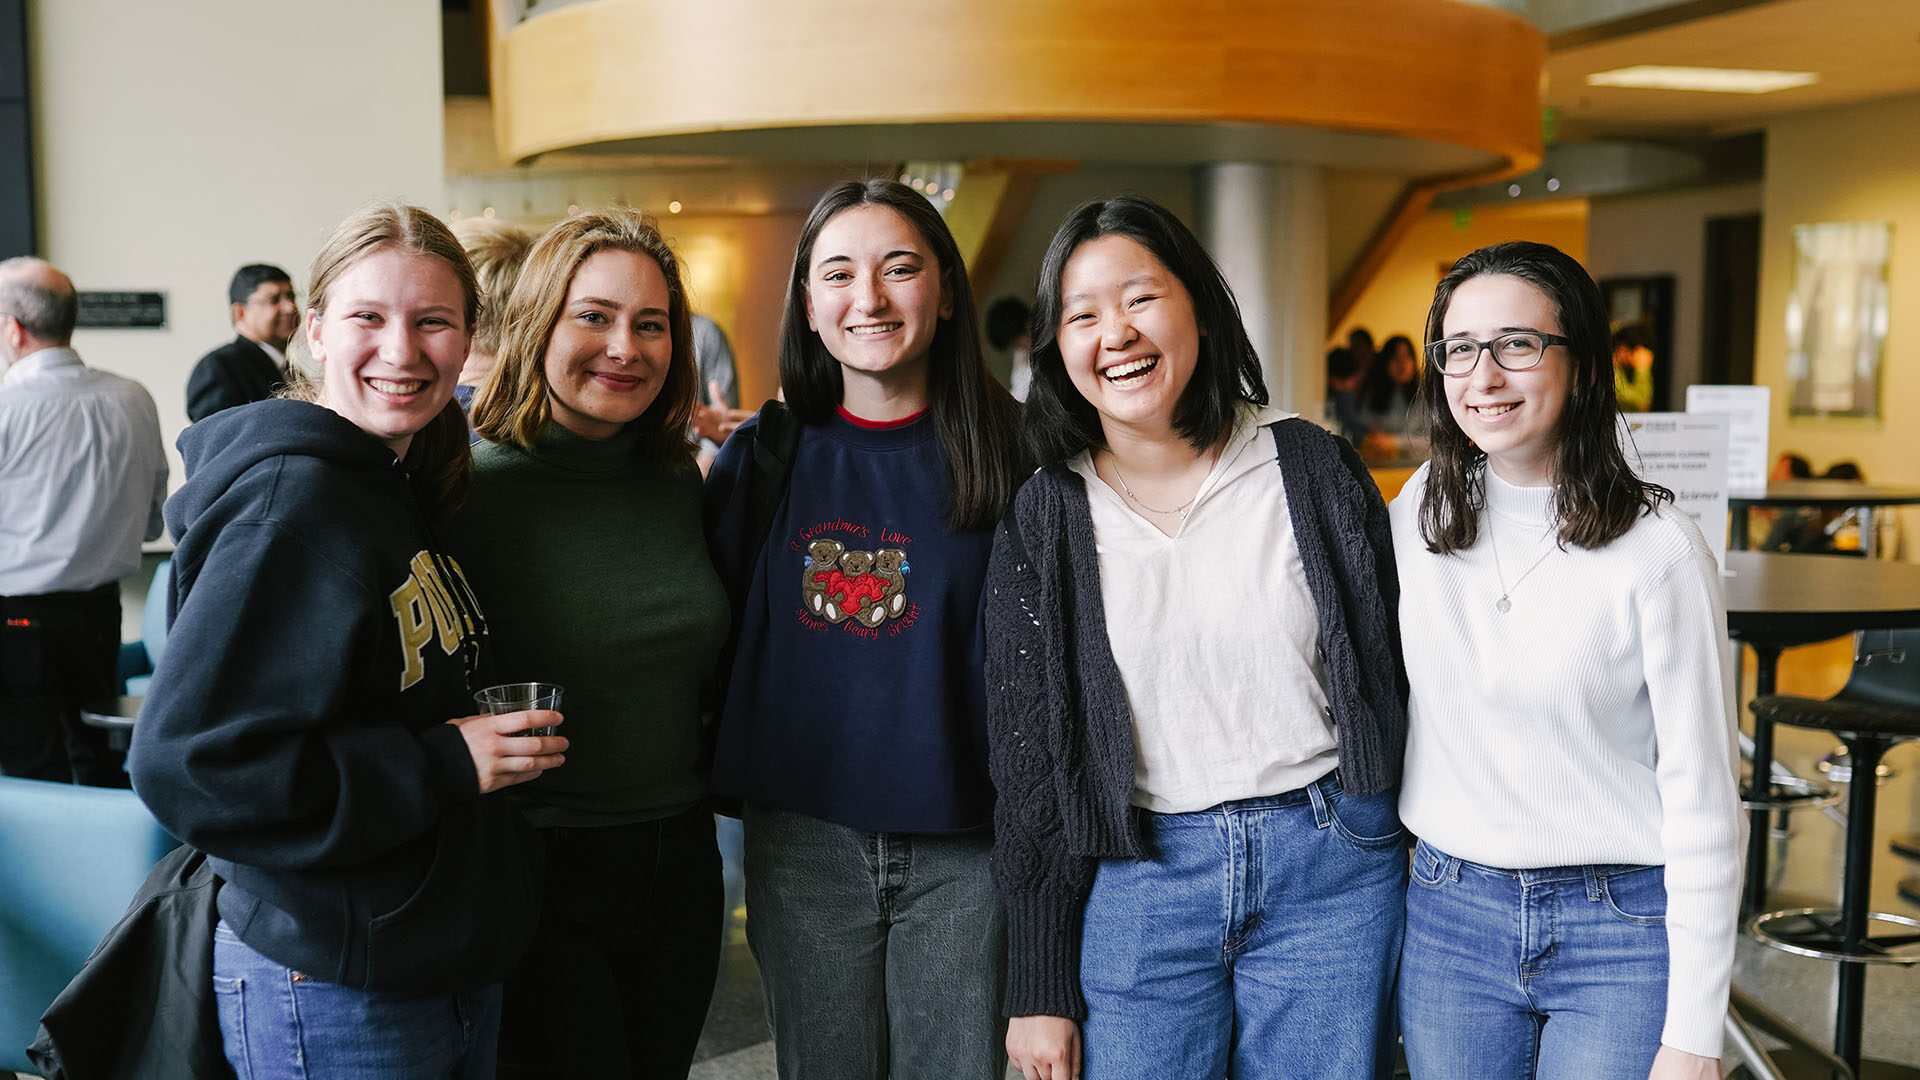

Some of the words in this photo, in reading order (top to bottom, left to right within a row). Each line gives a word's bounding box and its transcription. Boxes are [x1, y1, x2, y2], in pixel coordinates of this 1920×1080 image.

[799, 516, 870, 541] Grandma's
[880, 527, 913, 547] Love
[843, 619, 879, 640] Beary
